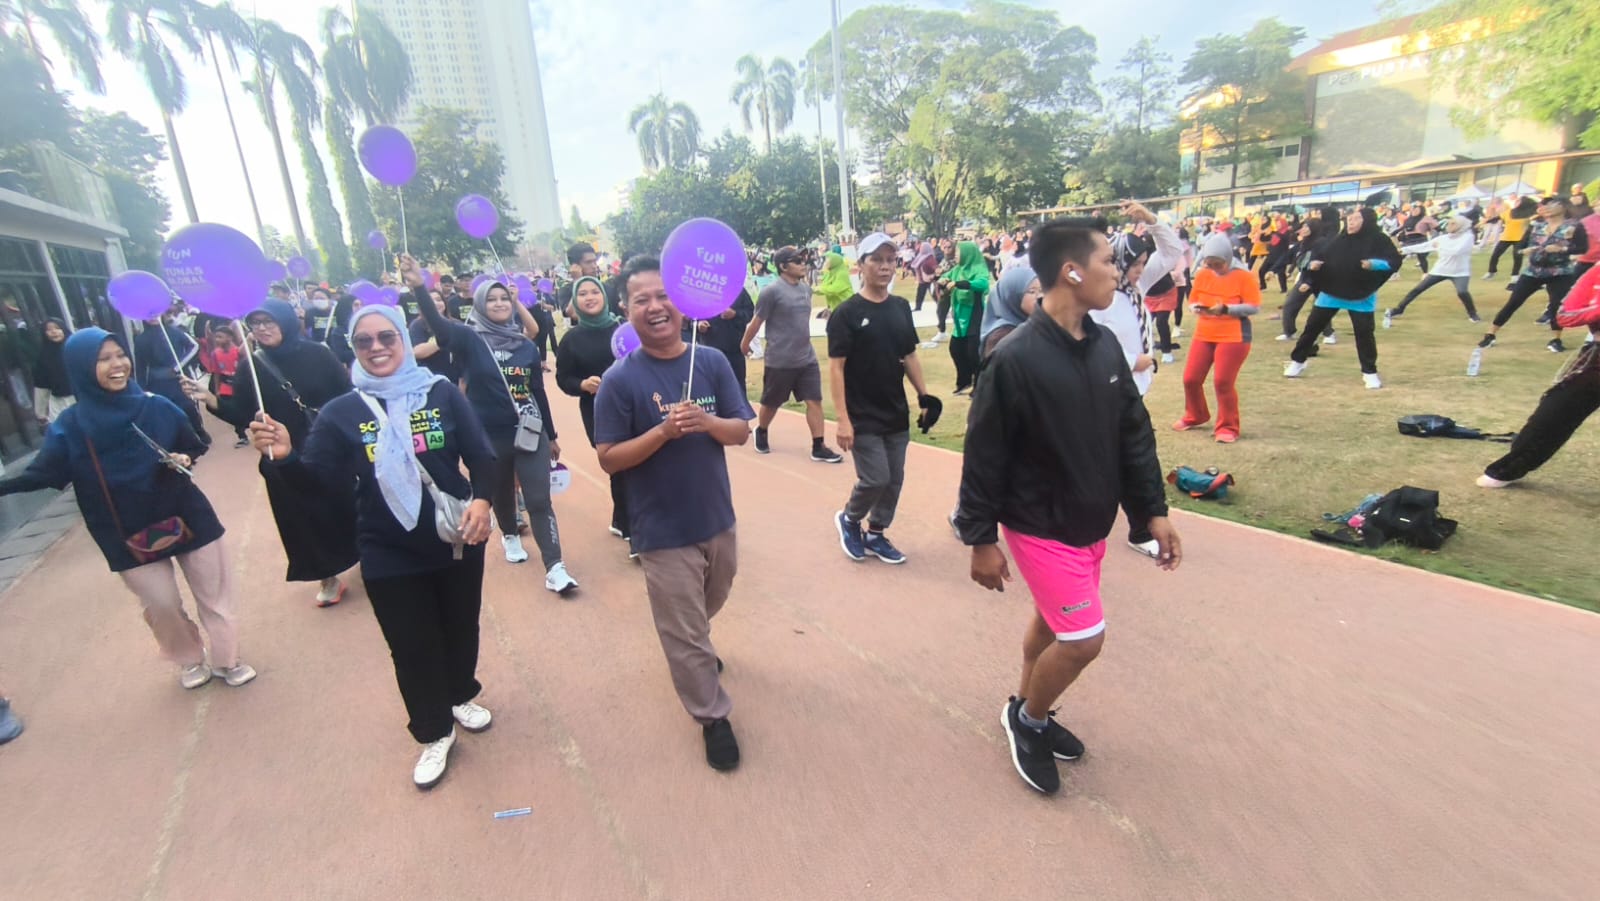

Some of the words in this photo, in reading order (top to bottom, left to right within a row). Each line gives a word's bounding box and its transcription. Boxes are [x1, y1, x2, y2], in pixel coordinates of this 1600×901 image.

[697, 246, 726, 265] FUN
[681, 275, 724, 294] GLOBAL
[683, 264, 728, 286] TUNAS
